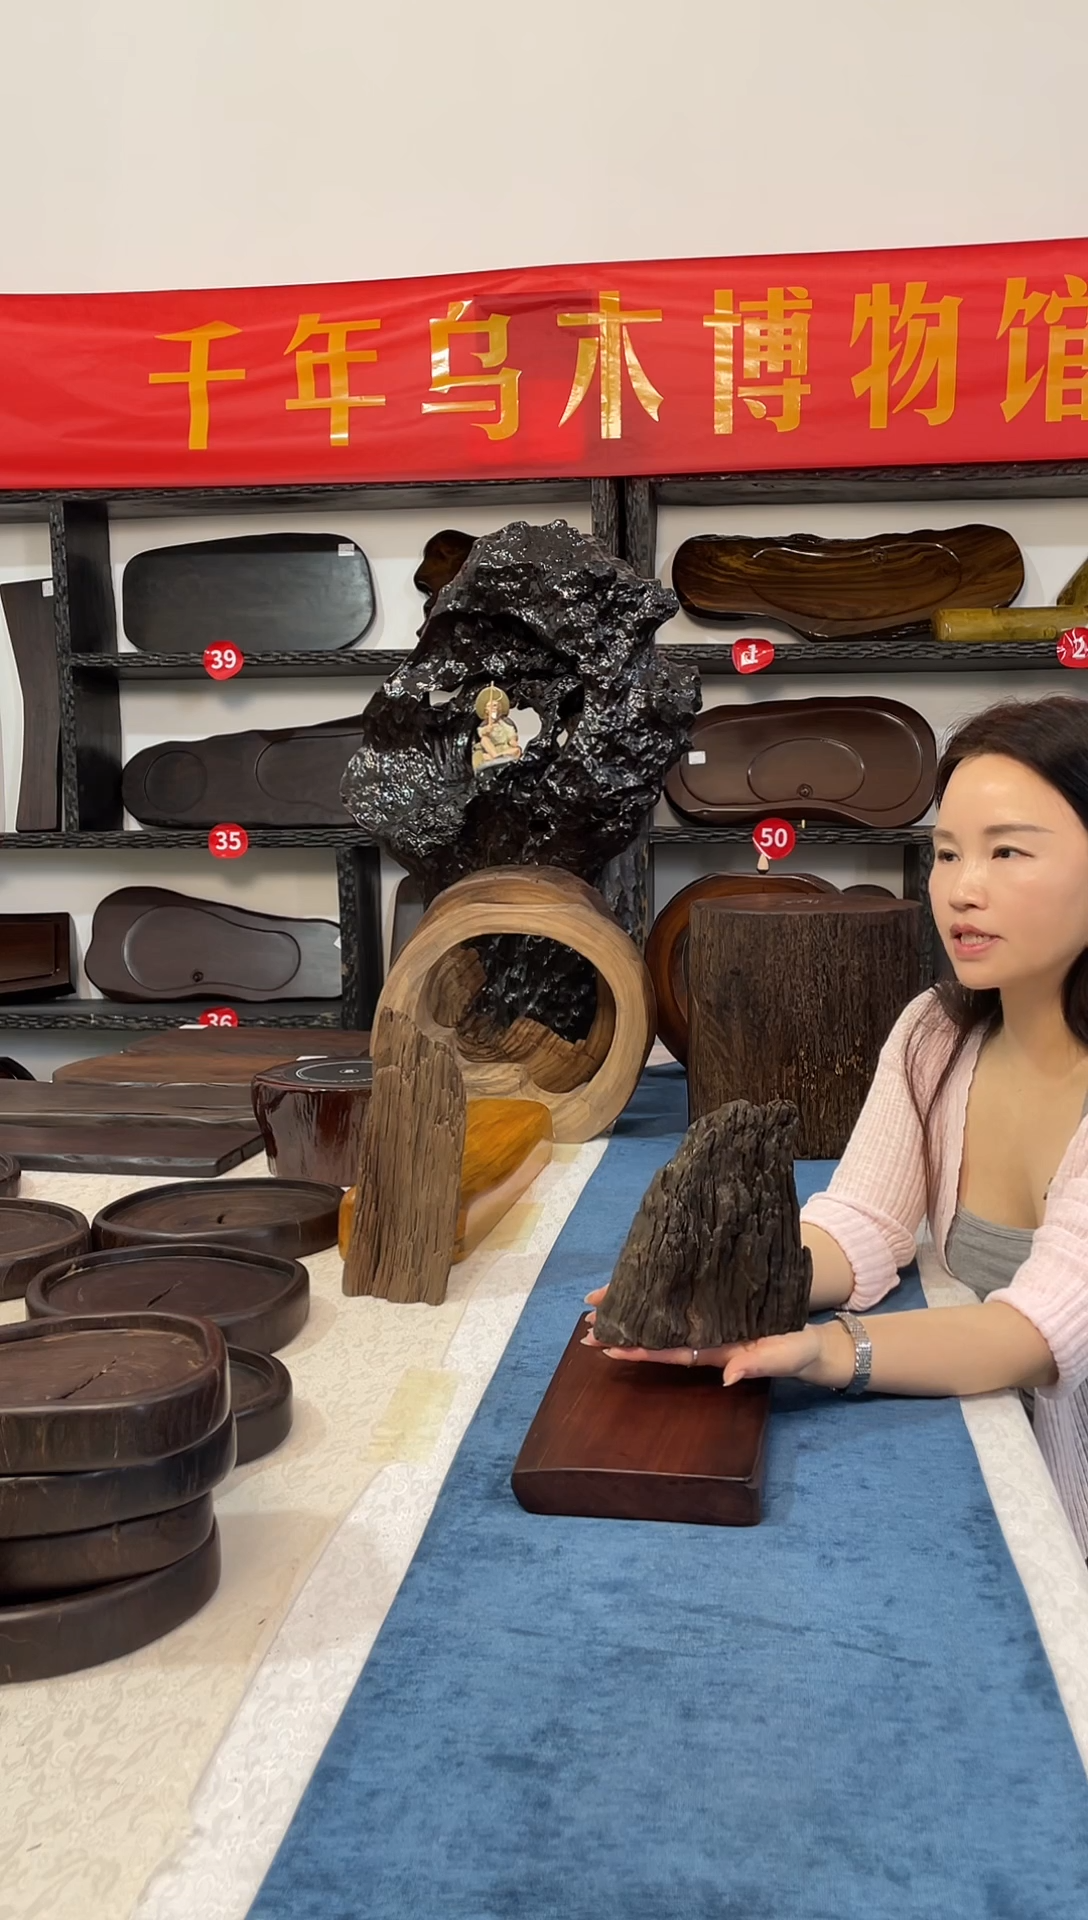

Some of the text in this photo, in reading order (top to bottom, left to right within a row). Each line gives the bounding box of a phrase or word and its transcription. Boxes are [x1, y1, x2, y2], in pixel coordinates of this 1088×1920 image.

[148, 274, 1088, 450] 千年乌木博物馆
[211, 649, 237, 669] 39
[215, 831, 241, 850] 35
[760, 827, 788, 848] 50
